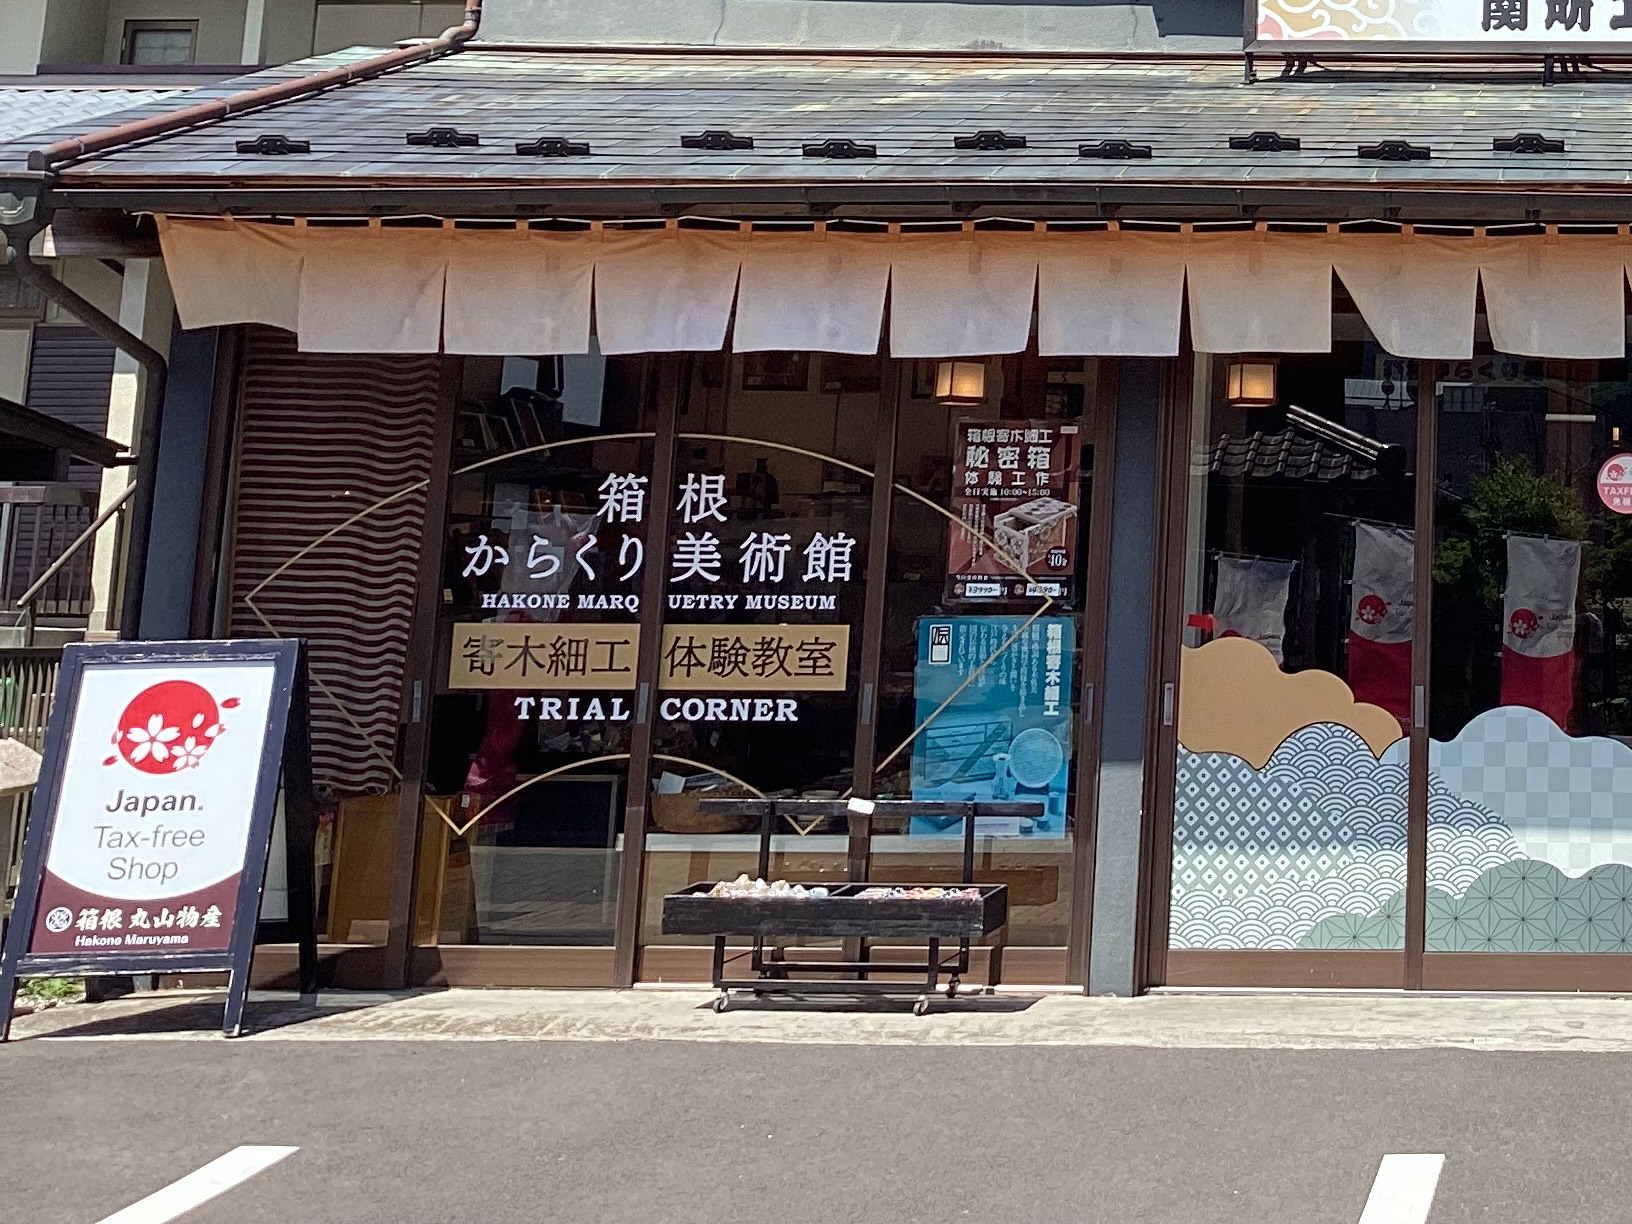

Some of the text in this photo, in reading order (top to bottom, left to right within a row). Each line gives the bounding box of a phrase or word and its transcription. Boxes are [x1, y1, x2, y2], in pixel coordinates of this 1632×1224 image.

[965, 445, 1051, 470] 秘密箱
[481, 594, 570, 609] HAKONE
[745, 595, 836, 610] MUSEUM
[463, 635, 837, 678] 寄木細工 体験教室
[514, 696, 799, 722] TRIAL CORNER
[105, 789, 204, 817] Japan.
[94, 824, 205, 849] Tax-free
[107, 856, 178, 885] Shop
[75, 905, 223, 931] 箱根 丸山物産
[75, 933, 189, 947] Hakone Maruyama
